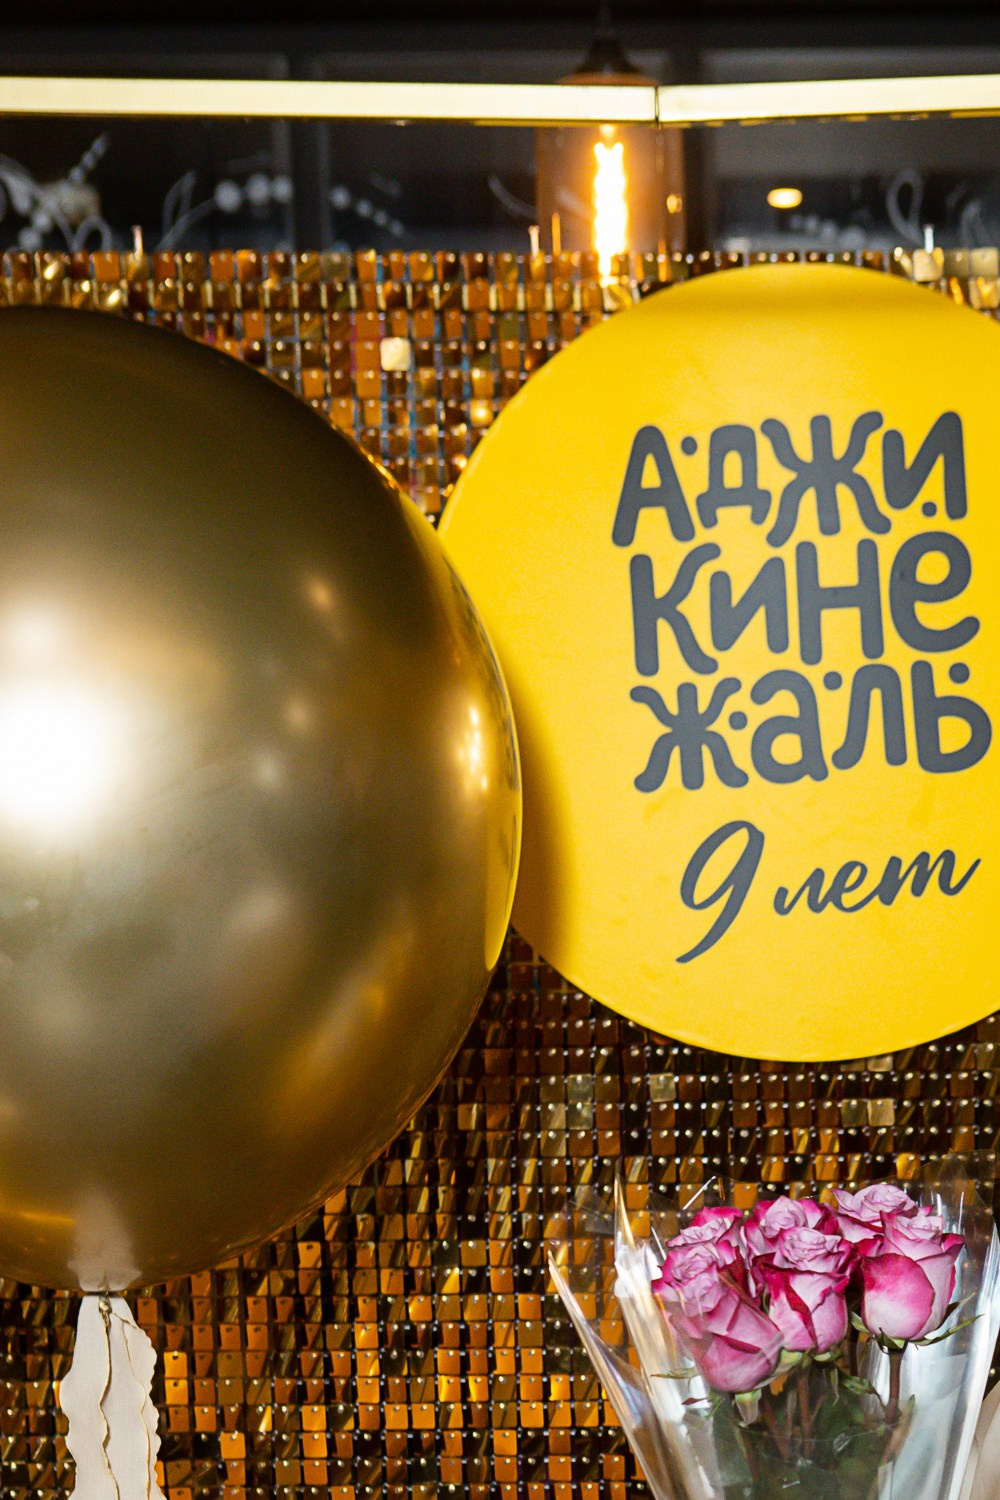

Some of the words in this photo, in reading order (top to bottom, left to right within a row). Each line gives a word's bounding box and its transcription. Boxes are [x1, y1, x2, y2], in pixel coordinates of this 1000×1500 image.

[611, 410, 968, 549] АДЖИ
[675, 820, 765, 964] 9
[773, 849, 981, 916] лет
